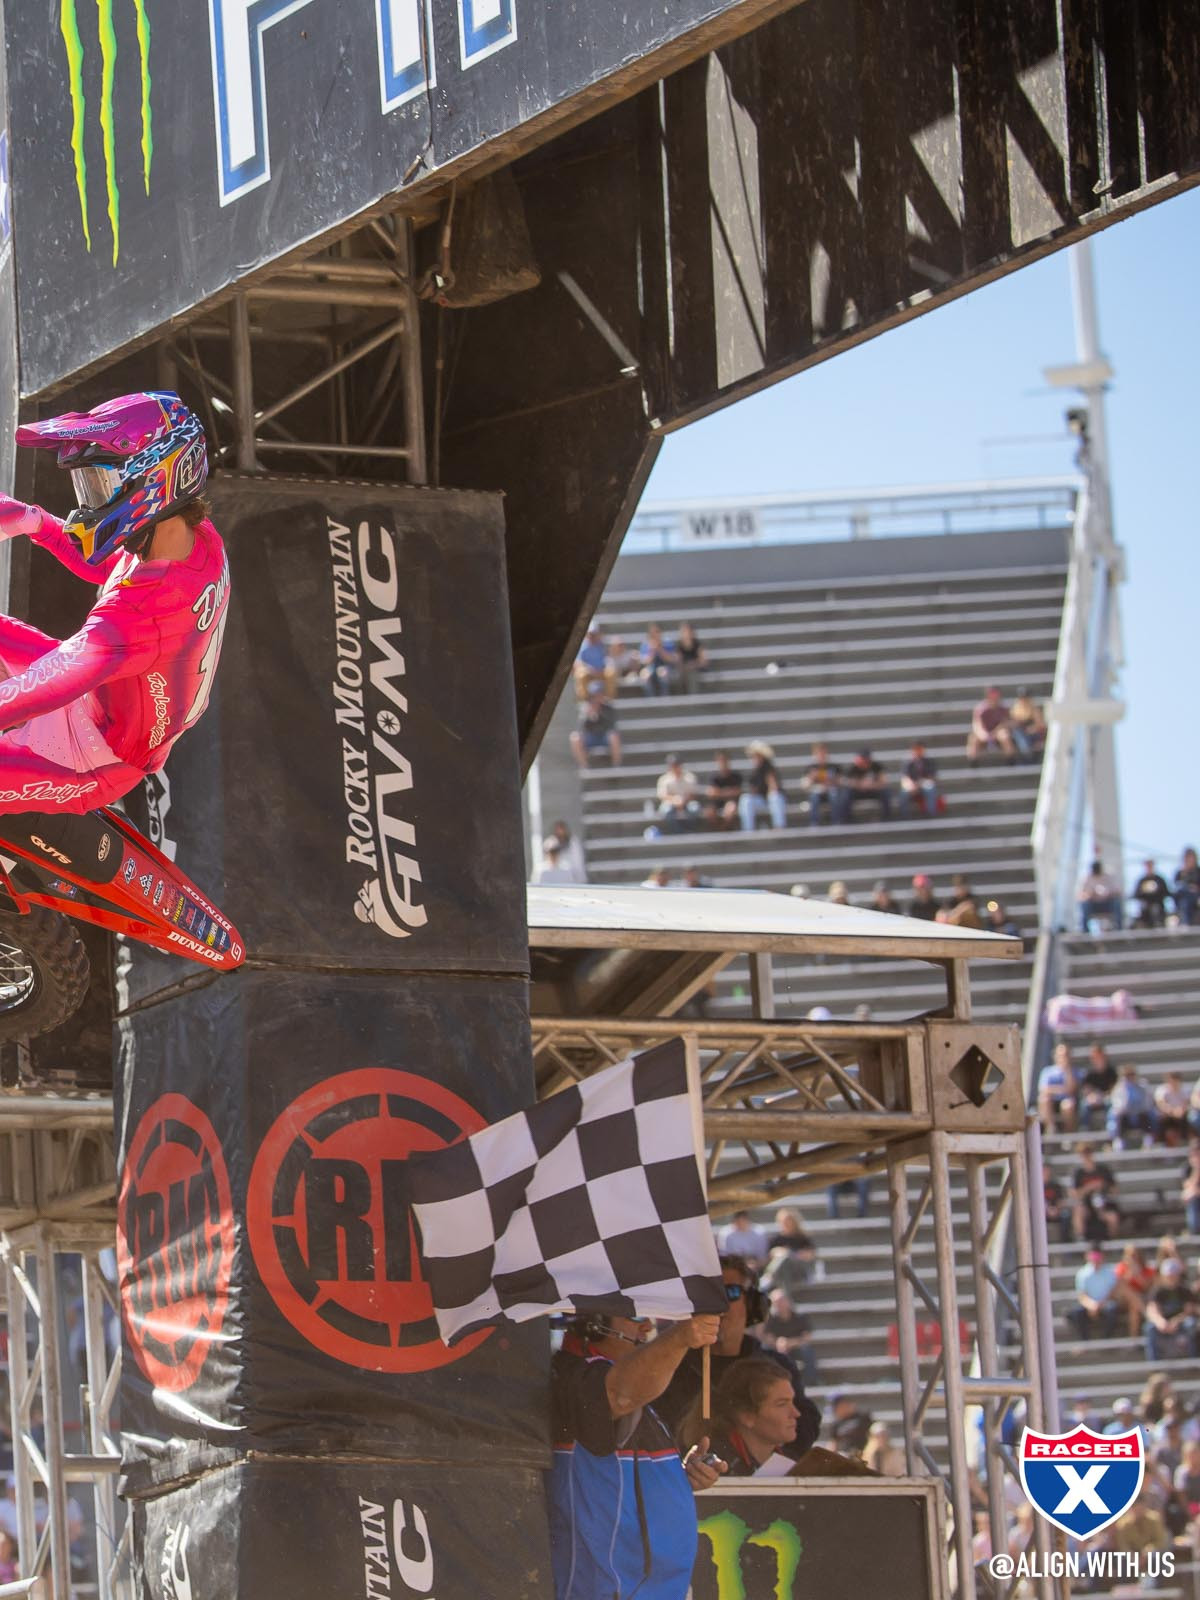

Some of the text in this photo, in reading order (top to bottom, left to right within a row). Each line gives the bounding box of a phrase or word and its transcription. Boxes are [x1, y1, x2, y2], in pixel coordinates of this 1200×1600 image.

[326, 517, 377, 870] ROCKY MOUNTAIN
[30, 834, 73, 865] GUTS
[166, 930, 225, 962] DUNLOP
